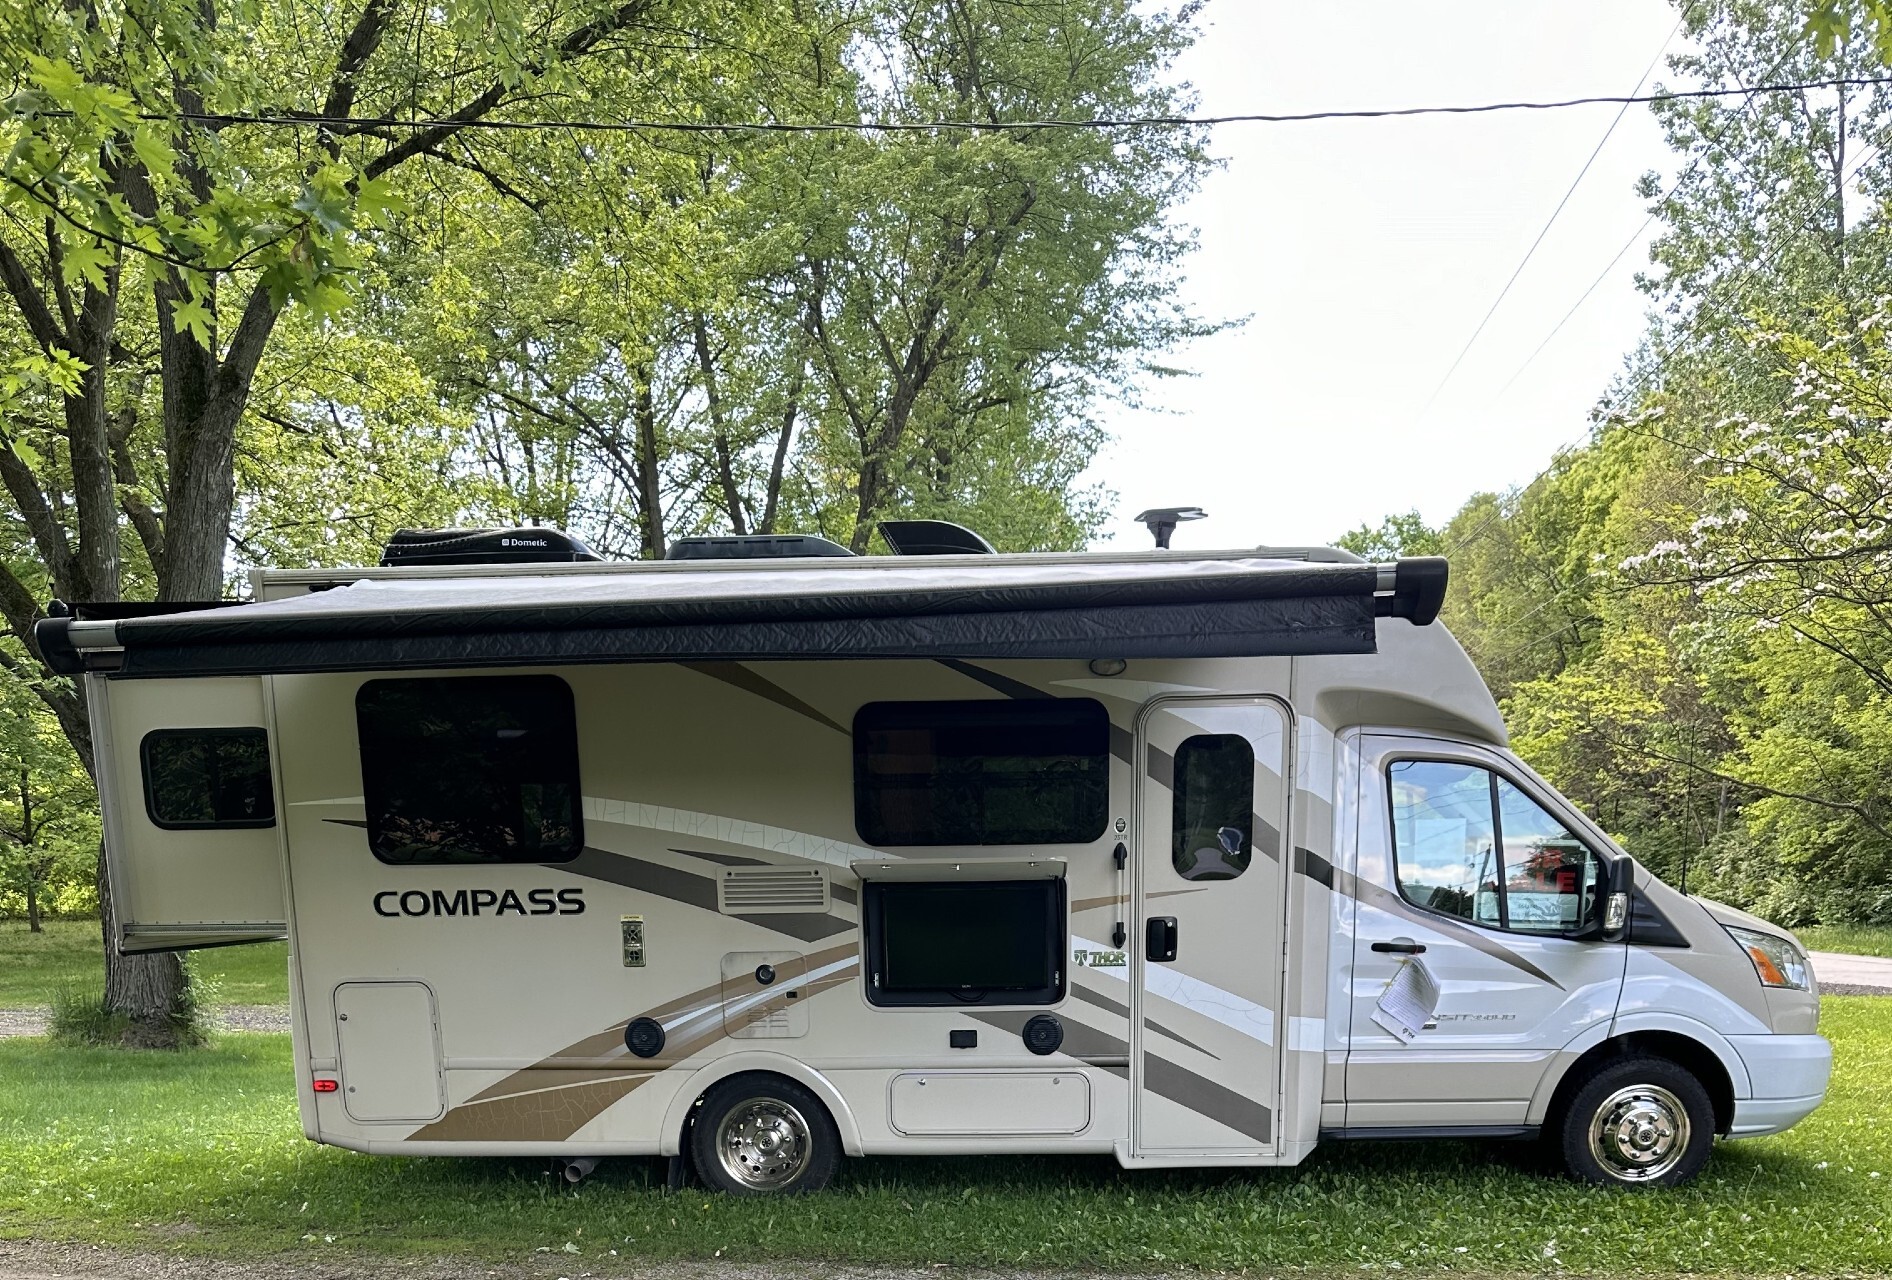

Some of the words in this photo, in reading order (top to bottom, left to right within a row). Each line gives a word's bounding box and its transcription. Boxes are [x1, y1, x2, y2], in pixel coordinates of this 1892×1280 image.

[511, 538, 548, 547] Dometic
[373, 888, 586, 917] COMPASS
[1089, 951, 1126, 963] THOR
